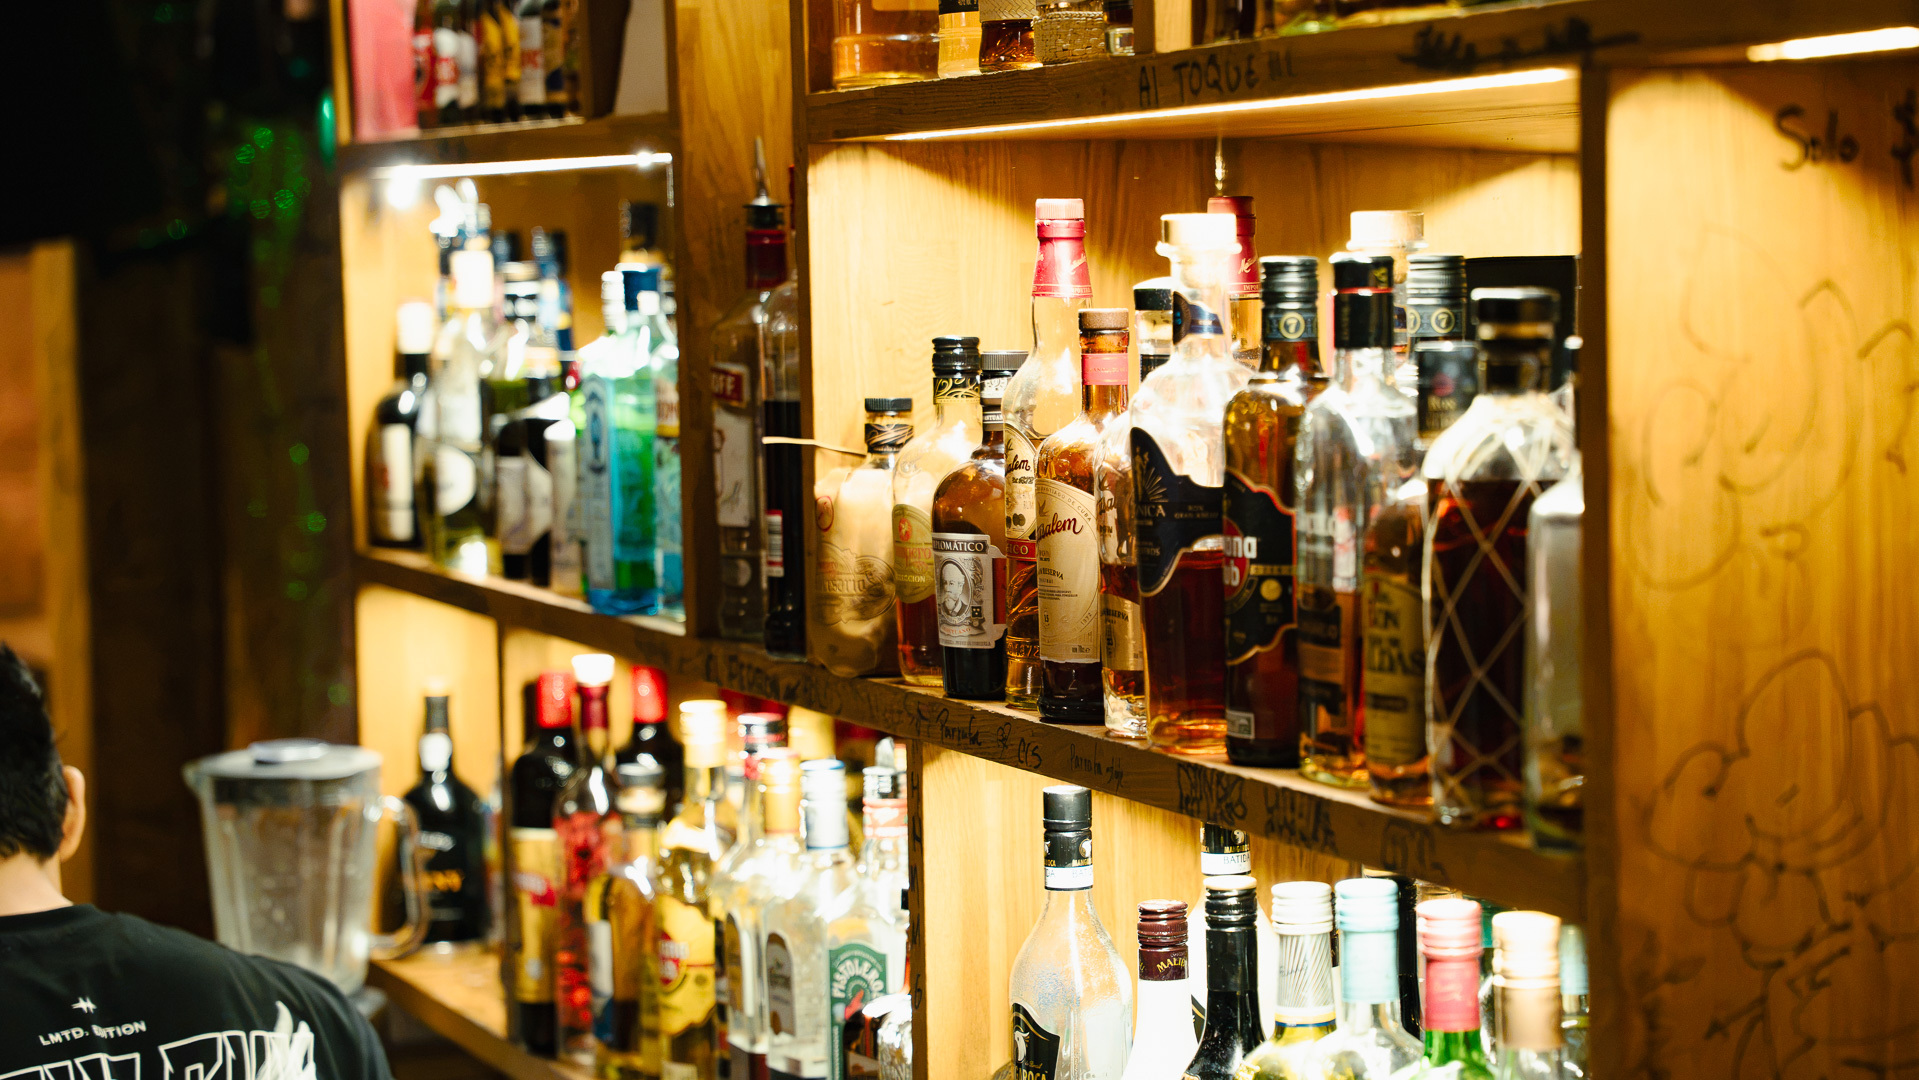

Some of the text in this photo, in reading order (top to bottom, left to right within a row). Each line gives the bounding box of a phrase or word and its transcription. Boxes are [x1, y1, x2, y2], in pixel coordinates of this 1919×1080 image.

[1172, 53, 1260, 103] TOQUE
[1286, 317, 1299, 334] 7
[1437, 313, 1450, 329] 7
[1077, 505, 1092, 522] CUBA
